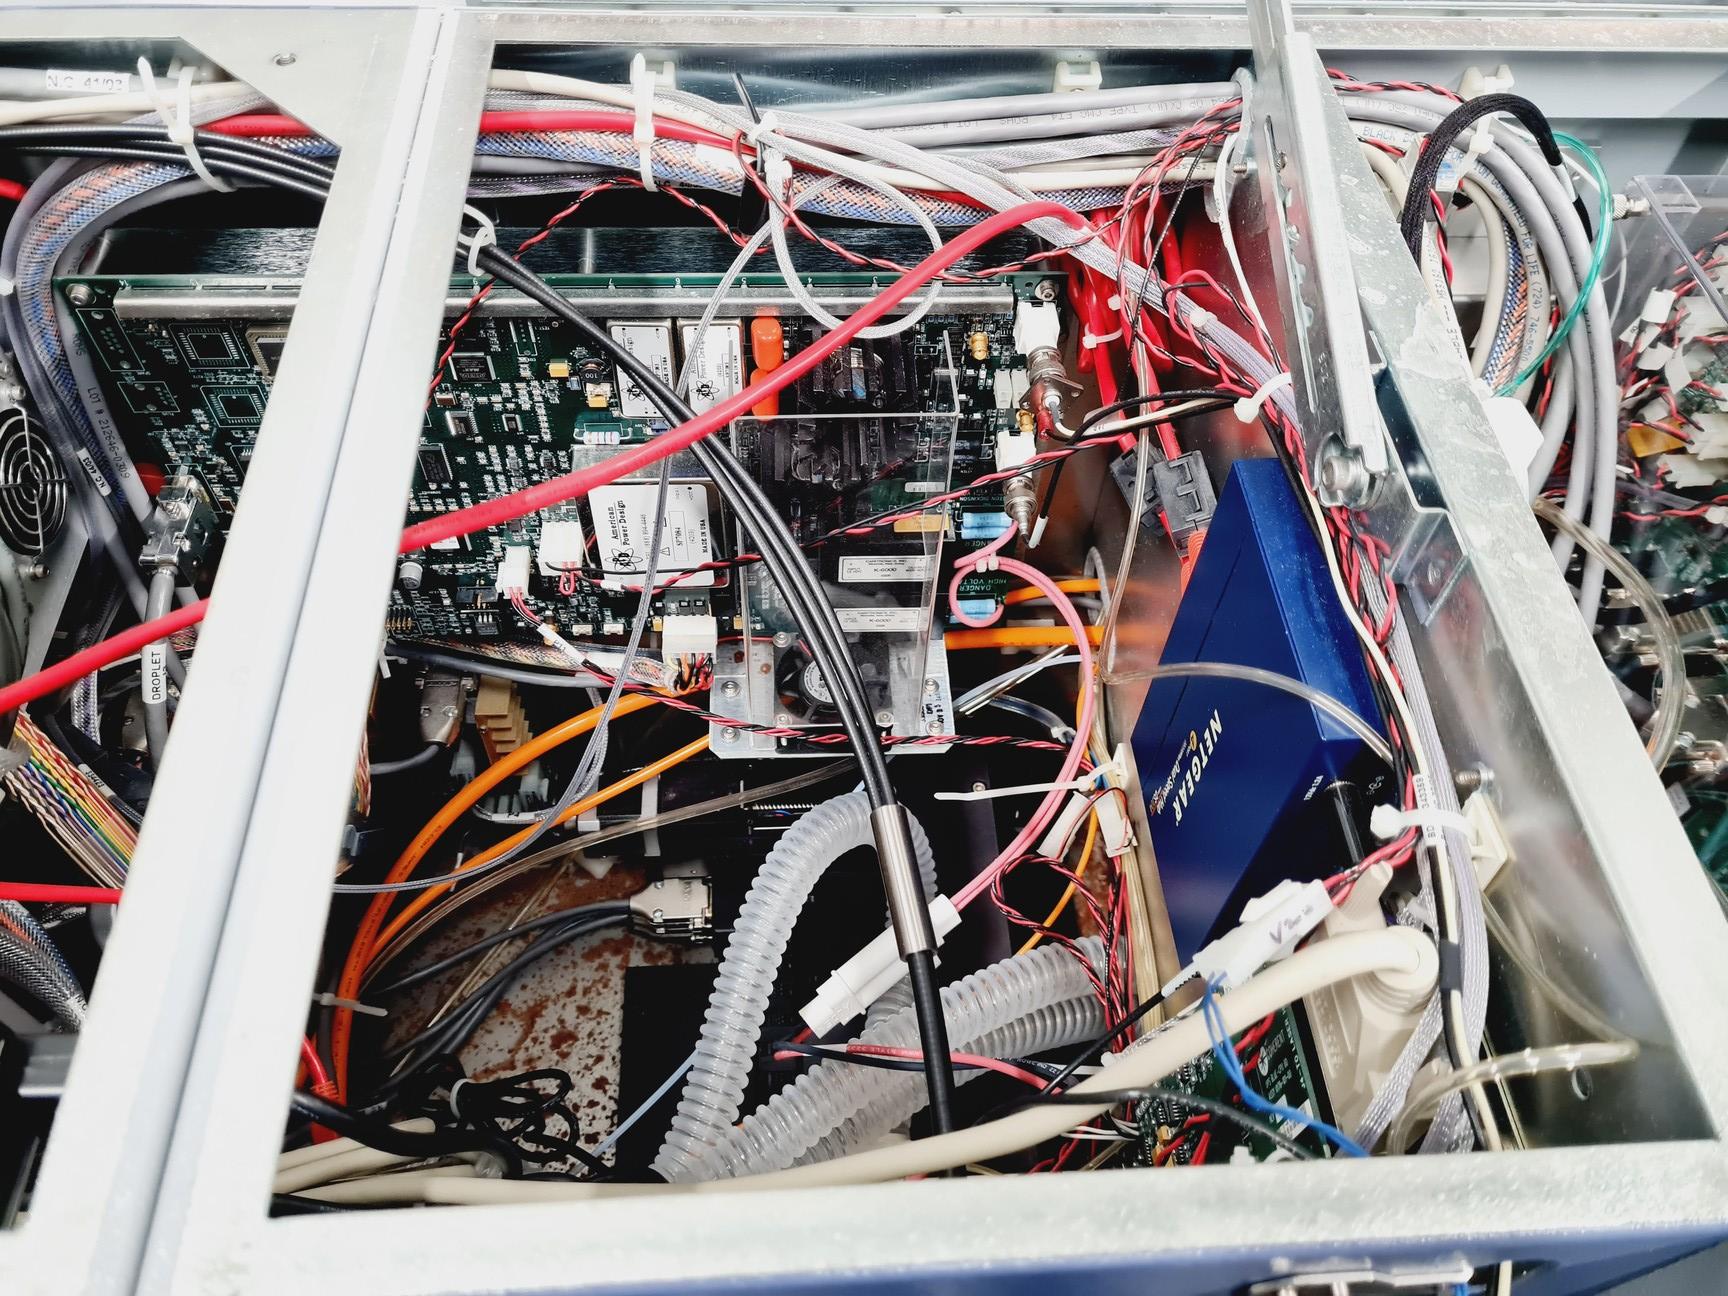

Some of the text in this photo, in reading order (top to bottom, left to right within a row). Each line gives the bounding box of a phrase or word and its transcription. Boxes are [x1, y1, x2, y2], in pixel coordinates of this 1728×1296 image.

[1363, 126, 1396, 142] BLACK
[1525, 252, 1540, 277] LIFE
[1531, 279, 1545, 310] (724)
[87, 387, 100, 404] LOT
[608, 506, 619, 540] American
[617, 500, 630, 546] Power Design
[152, 650, 162, 701] DROPLET
[1173, 709, 1222, 822] NETGEAR
